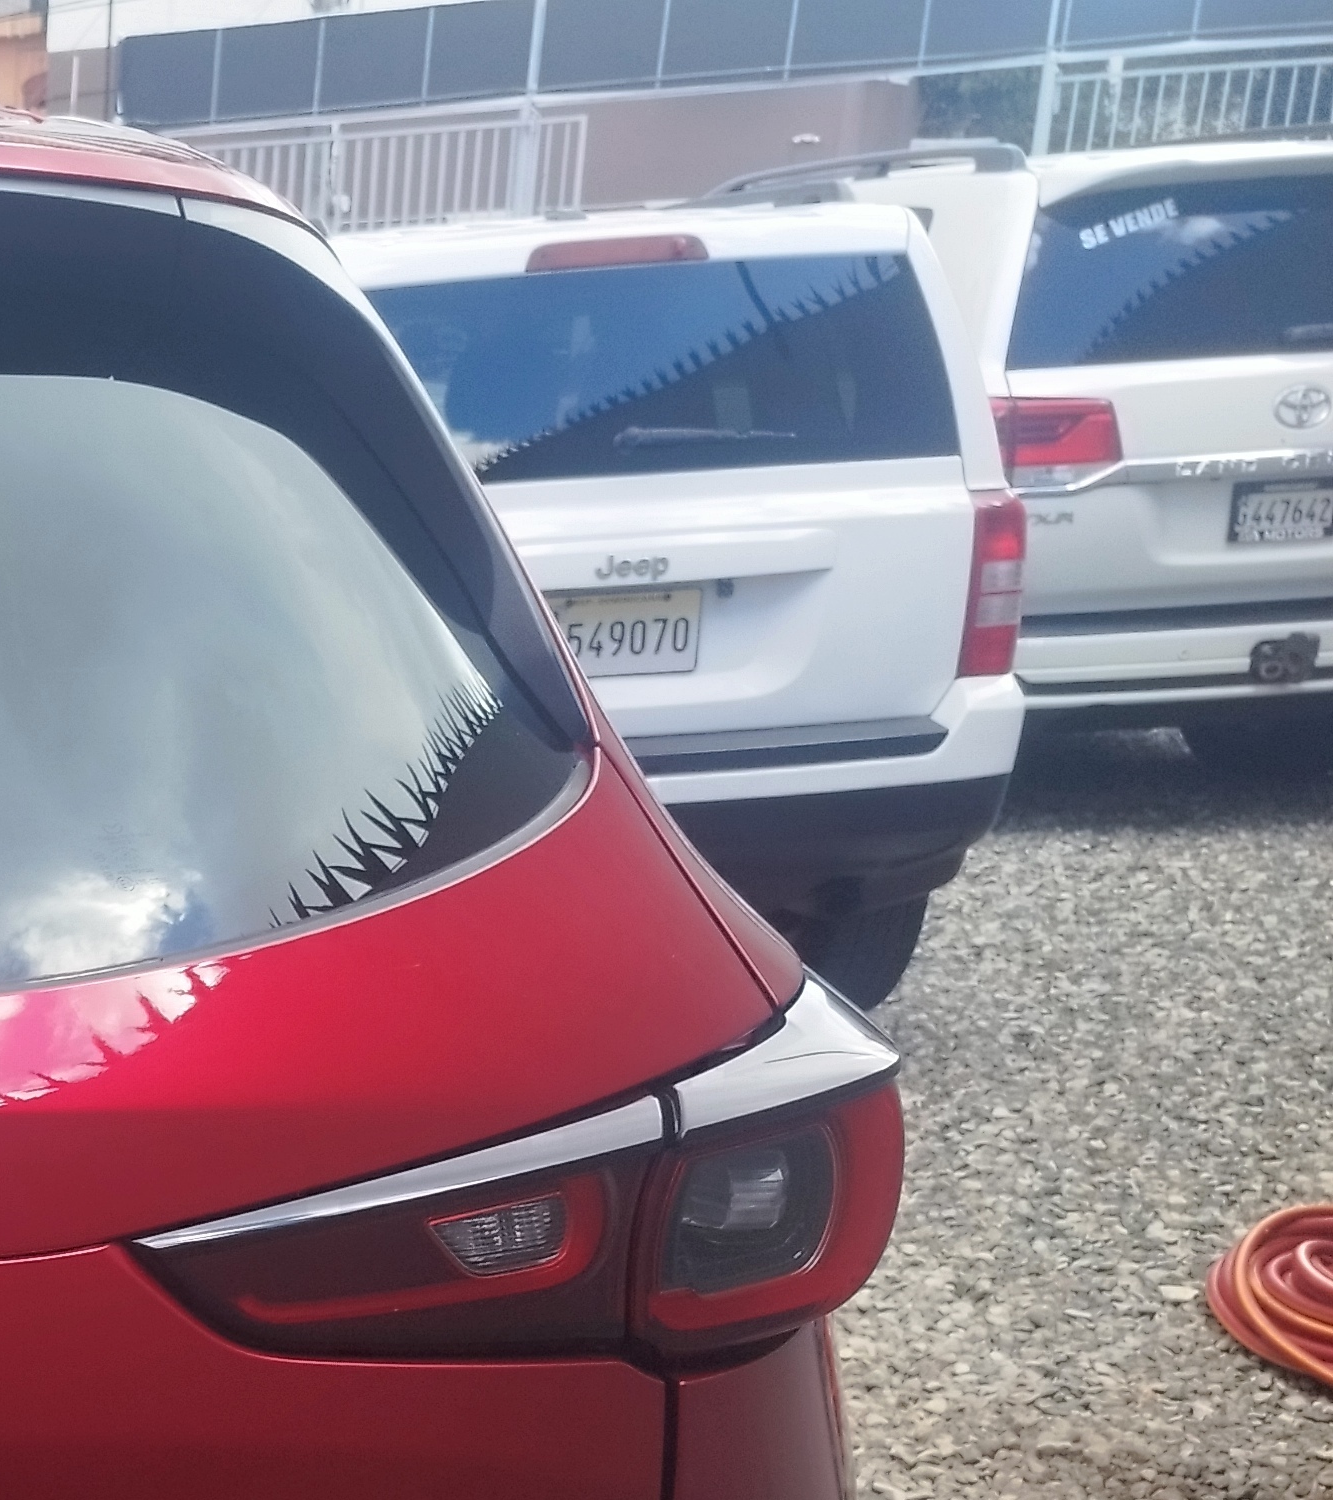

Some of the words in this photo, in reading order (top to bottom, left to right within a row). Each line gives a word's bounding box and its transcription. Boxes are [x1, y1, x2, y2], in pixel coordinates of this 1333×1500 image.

[1079, 224, 1110, 250] SE
[1108, 199, 1179, 238] VENDE
[595, 555, 669, 581] Jeep
